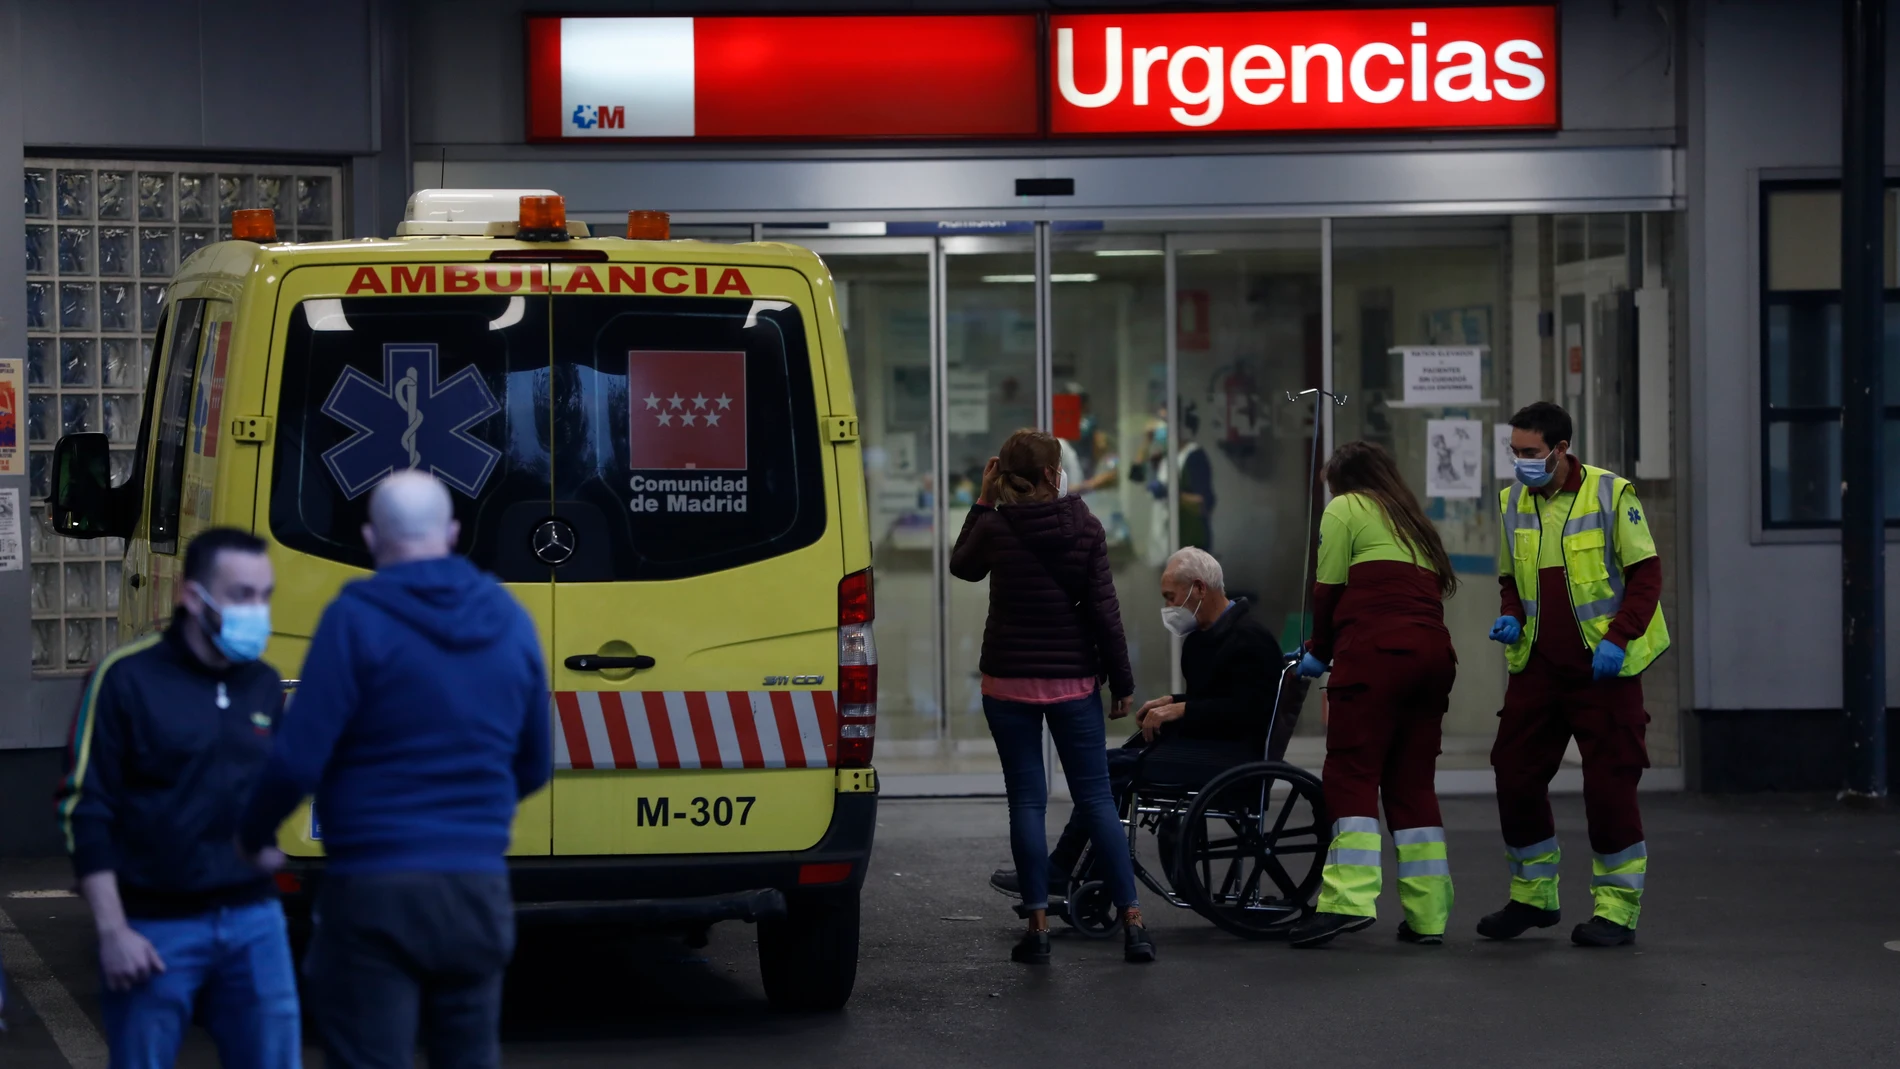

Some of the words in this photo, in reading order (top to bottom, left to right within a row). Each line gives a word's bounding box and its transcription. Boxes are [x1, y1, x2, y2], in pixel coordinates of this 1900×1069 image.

[1057, 22, 1546, 127] Urgencias
[597, 106, 625, 129] M
[345, 266, 752, 295] AMBULANCIA
[630, 475, 747, 492] Comunidad
[630, 494, 659, 512] de
[667, 494, 747, 512] Madrid
[792, 675, 824, 686] CDI
[637, 796, 756, 827] M-307
